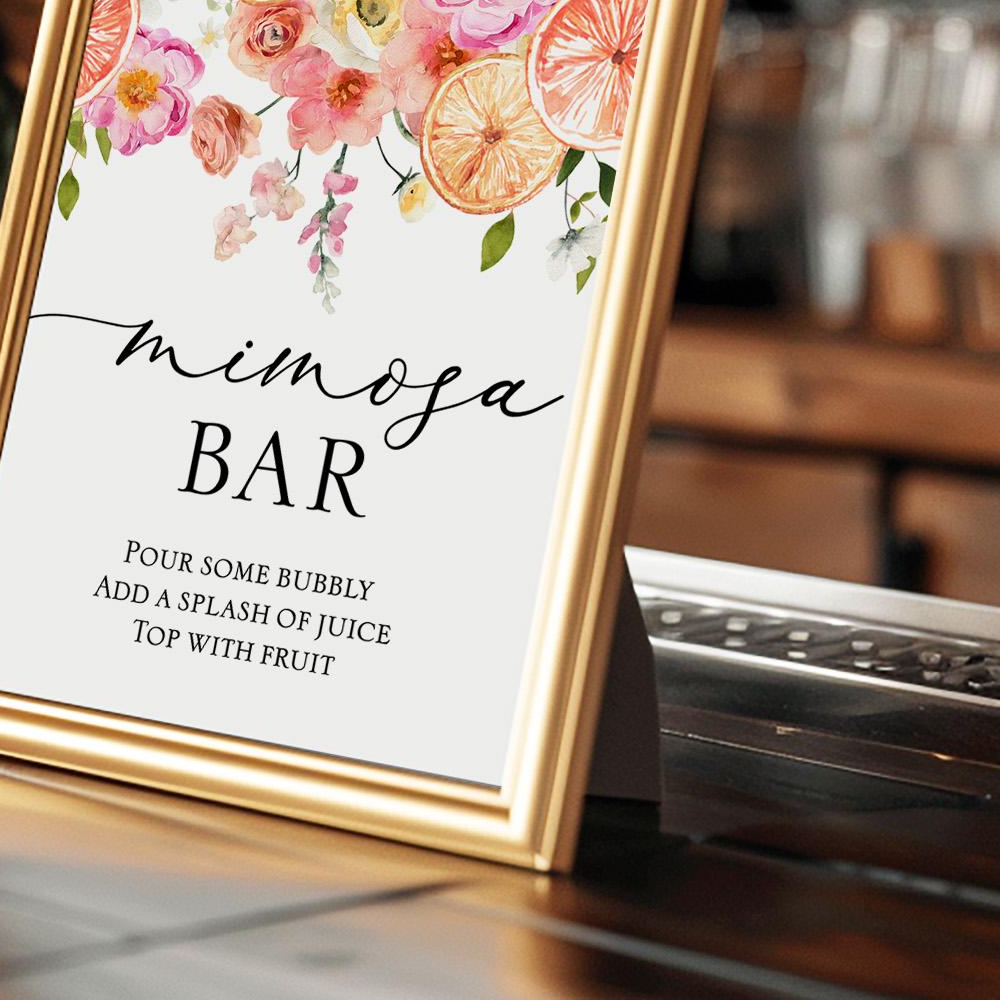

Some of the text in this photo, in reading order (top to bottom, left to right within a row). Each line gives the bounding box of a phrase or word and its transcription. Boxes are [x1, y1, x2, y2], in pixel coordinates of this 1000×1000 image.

[30, 313, 565, 451] mimosa
[177, 420, 366, 518] BAR
[123, 539, 376, 601] POUR SOME BUBBLY
[92, 575, 392, 645] ADD A SPLASH OF JUICE
[133, 618, 336, 676] TOP WITH FRUIT
